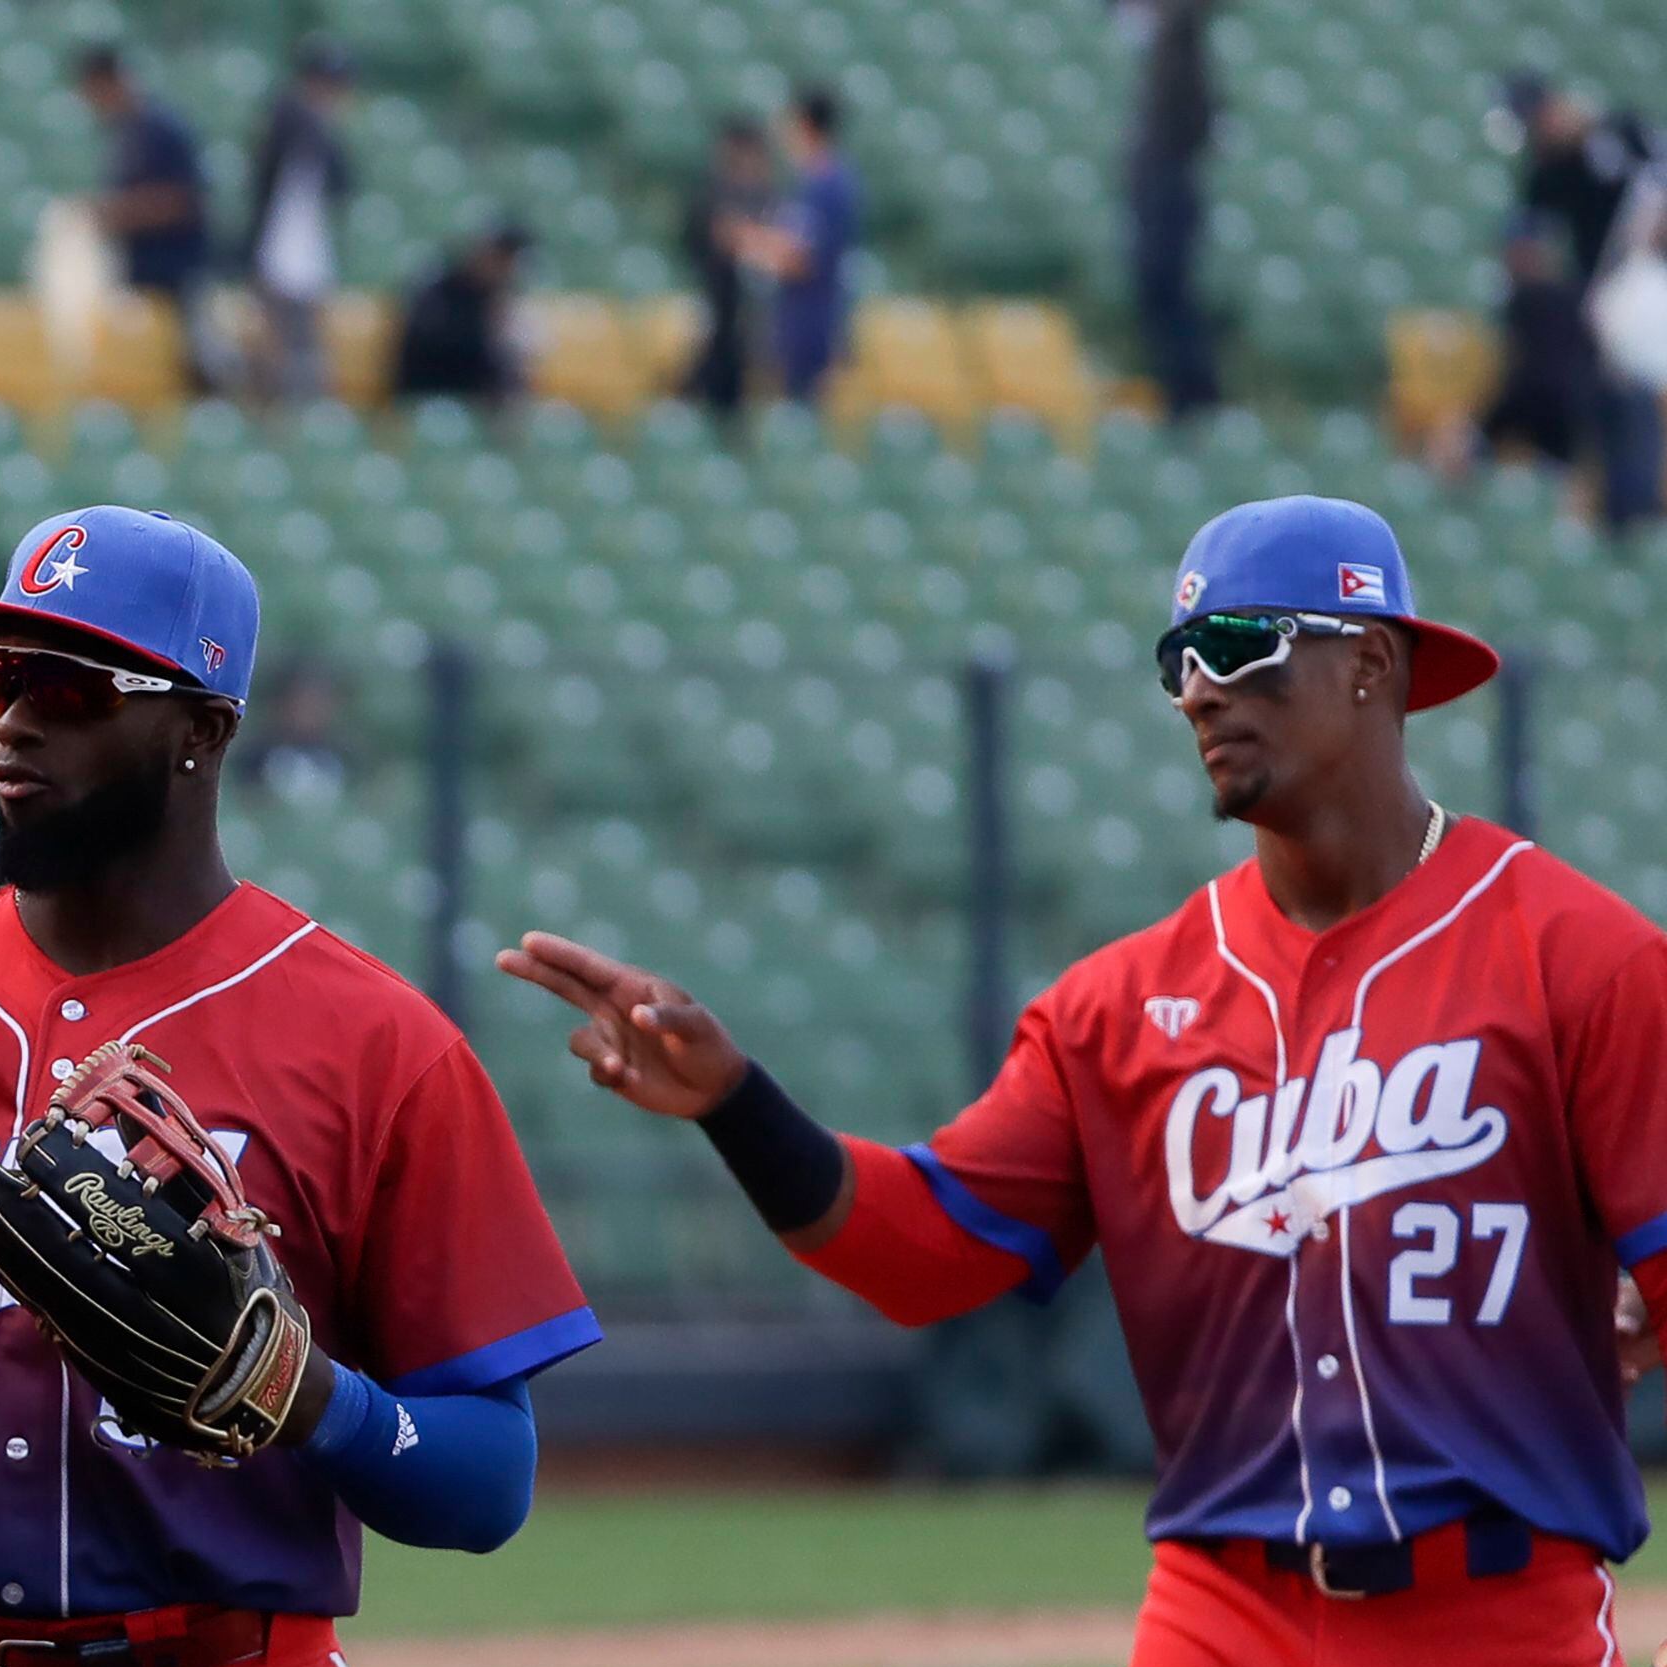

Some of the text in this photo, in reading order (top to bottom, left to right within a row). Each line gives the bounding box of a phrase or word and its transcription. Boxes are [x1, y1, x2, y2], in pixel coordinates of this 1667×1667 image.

[1165, 1027, 1507, 1240] Cuba
[64, 1172, 175, 1257] Rawlings
[1388, 1202, 1529, 1325] 27
